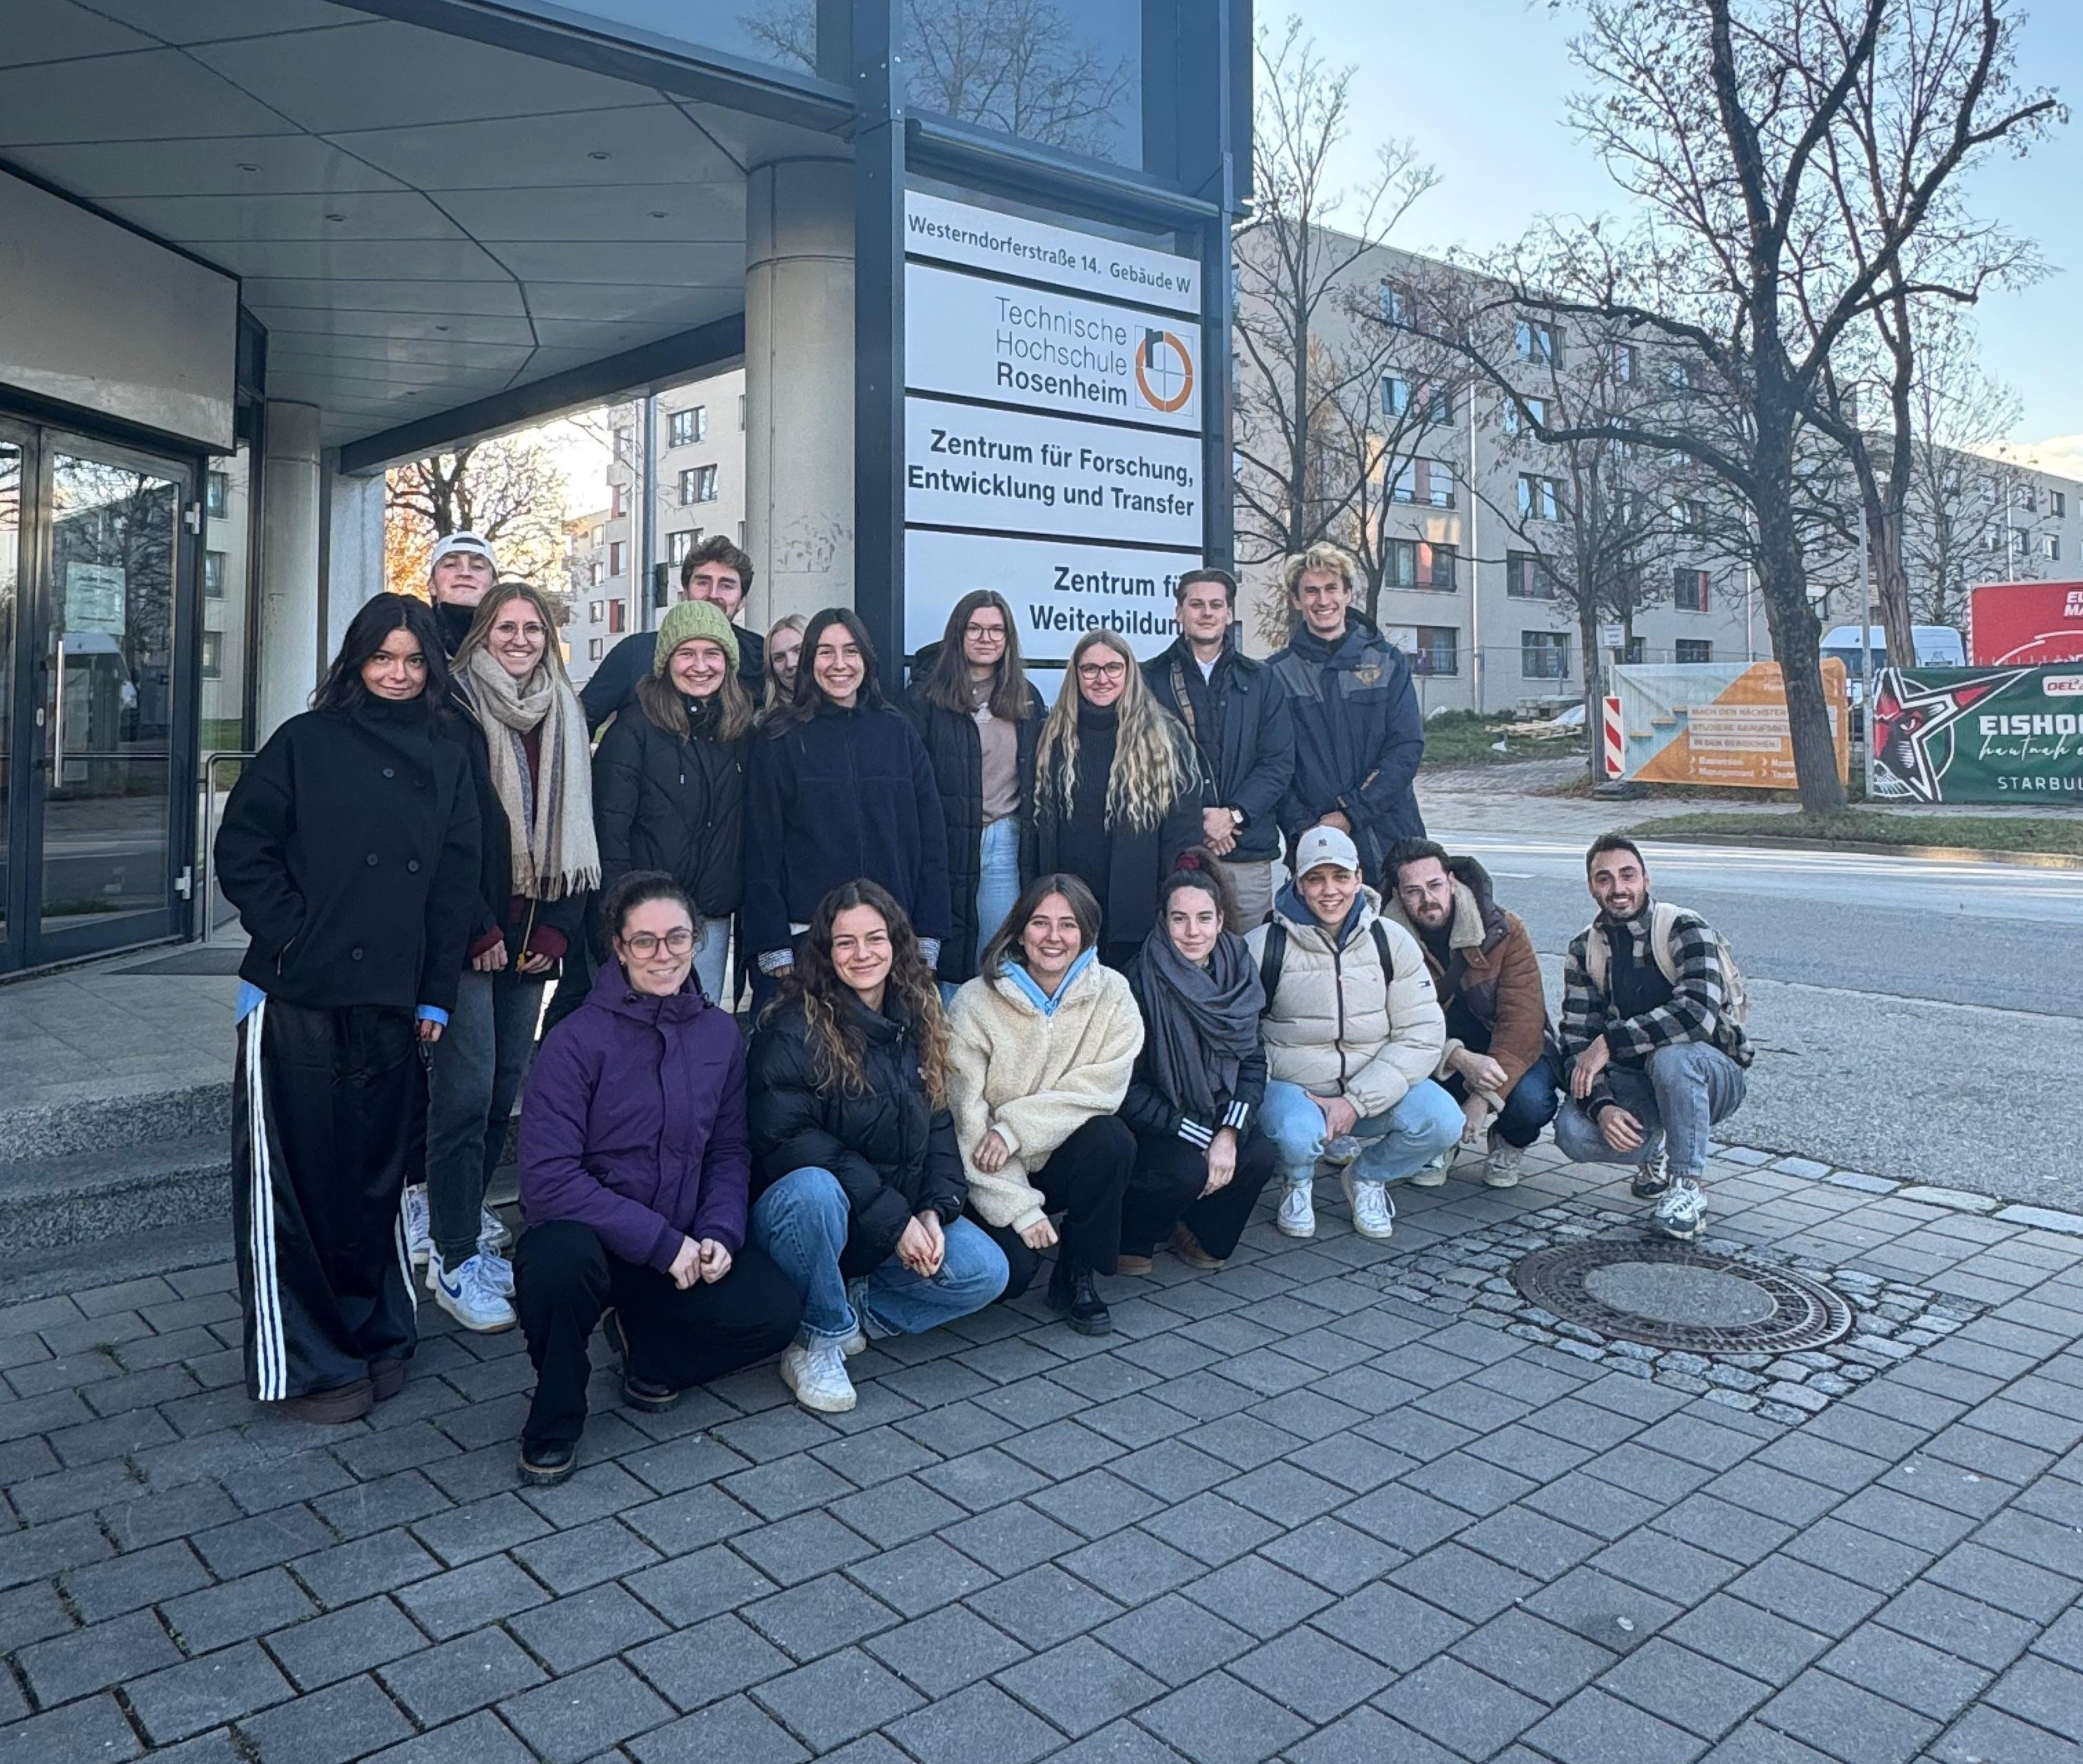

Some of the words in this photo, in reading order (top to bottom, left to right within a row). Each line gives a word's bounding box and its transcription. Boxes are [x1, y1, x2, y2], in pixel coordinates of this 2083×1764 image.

[908, 214, 1076, 268] Westerndorferstraße
[1081, 255, 1102, 274] 14.
[1109, 262, 1172, 291] Gebäude
[1176, 276, 1191, 293] W
[995, 296, 1127, 346] Technische
[996, 328, 1127, 376] Hochschule
[997, 360, 1128, 406] Rosenheim
[930, 428, 1033, 464] Zentrum
[1040, 444, 1072, 468] für
[1079, 448, 1194, 488] Forschung,
[908, 464, 1055, 507] Entwicklung
[1064, 484, 1103, 507] und
[1110, 486, 1195, 517] Transfer
[1053, 565, 1155, 596] Zentrum
[1163, 574, 1182, 598] fü
[1028, 604, 1183, 636] Weiterbildun
[1979, 714, 2083, 736] EISHO
